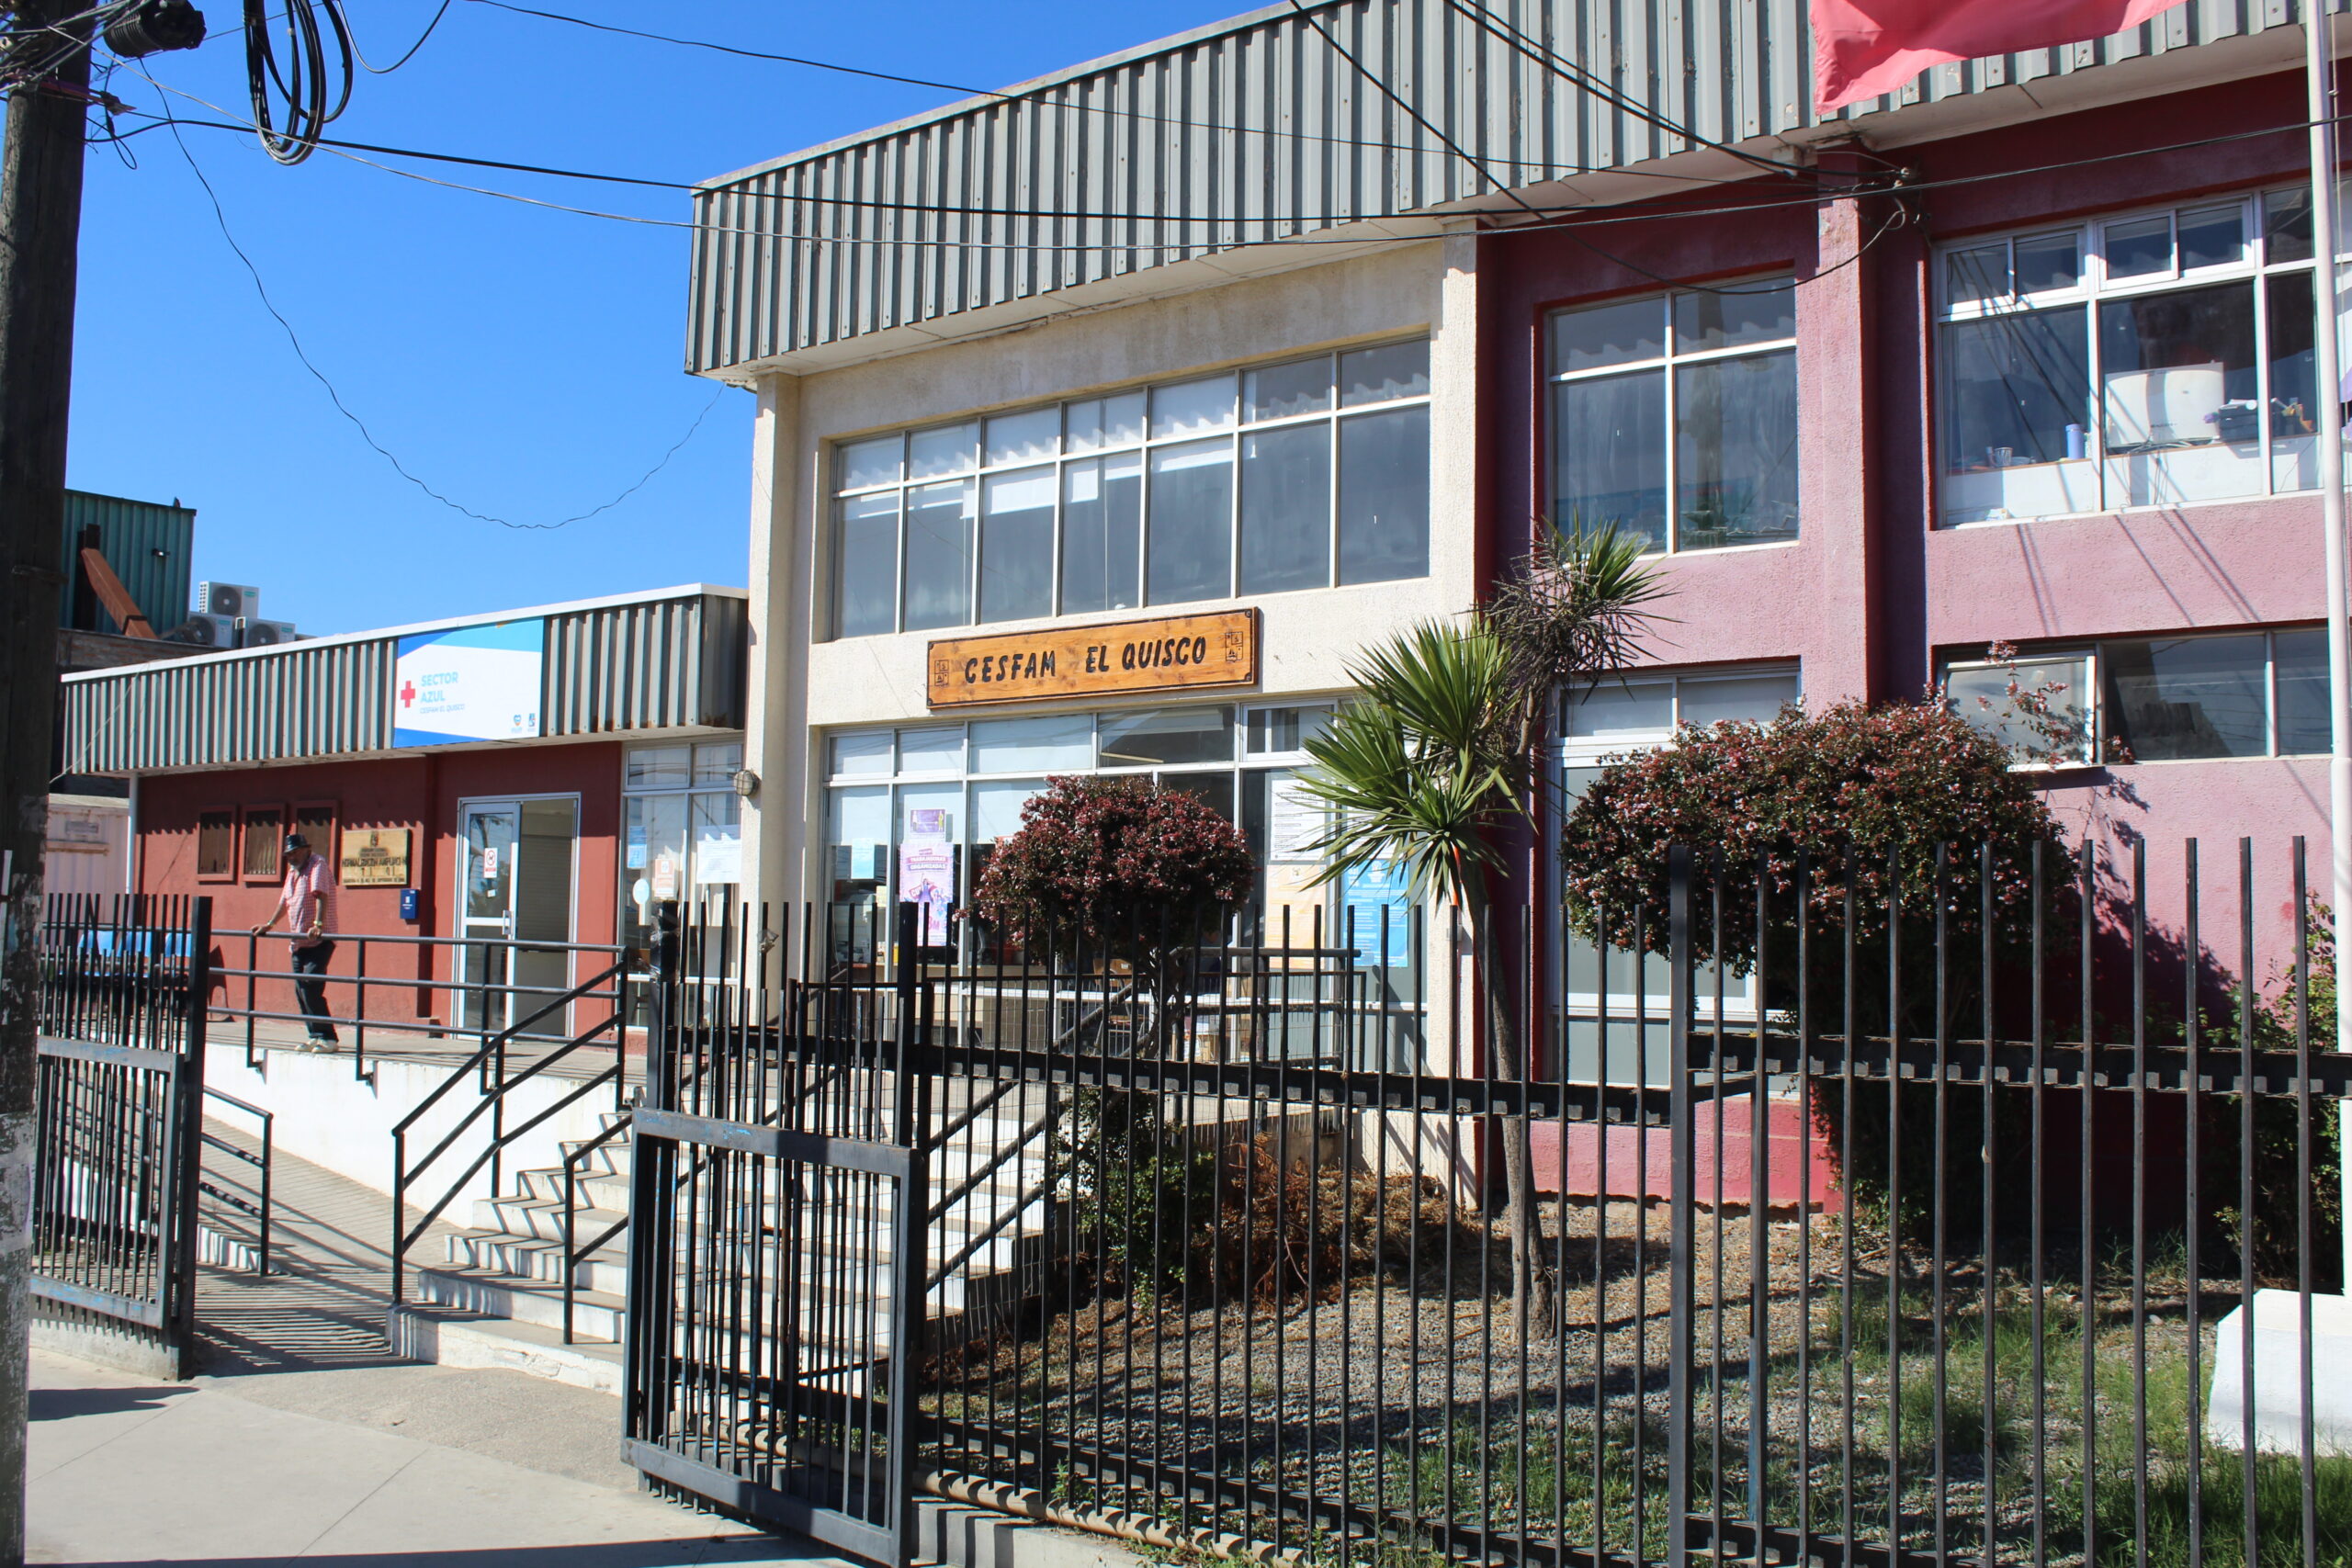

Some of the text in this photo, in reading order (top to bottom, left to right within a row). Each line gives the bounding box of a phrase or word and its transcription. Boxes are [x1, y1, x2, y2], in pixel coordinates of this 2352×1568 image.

[965, 636, 1207, 684] CESFAM EL QUISCO
[421, 671, 458, 687] SECTOR
[420, 690, 446, 704] AZUL
